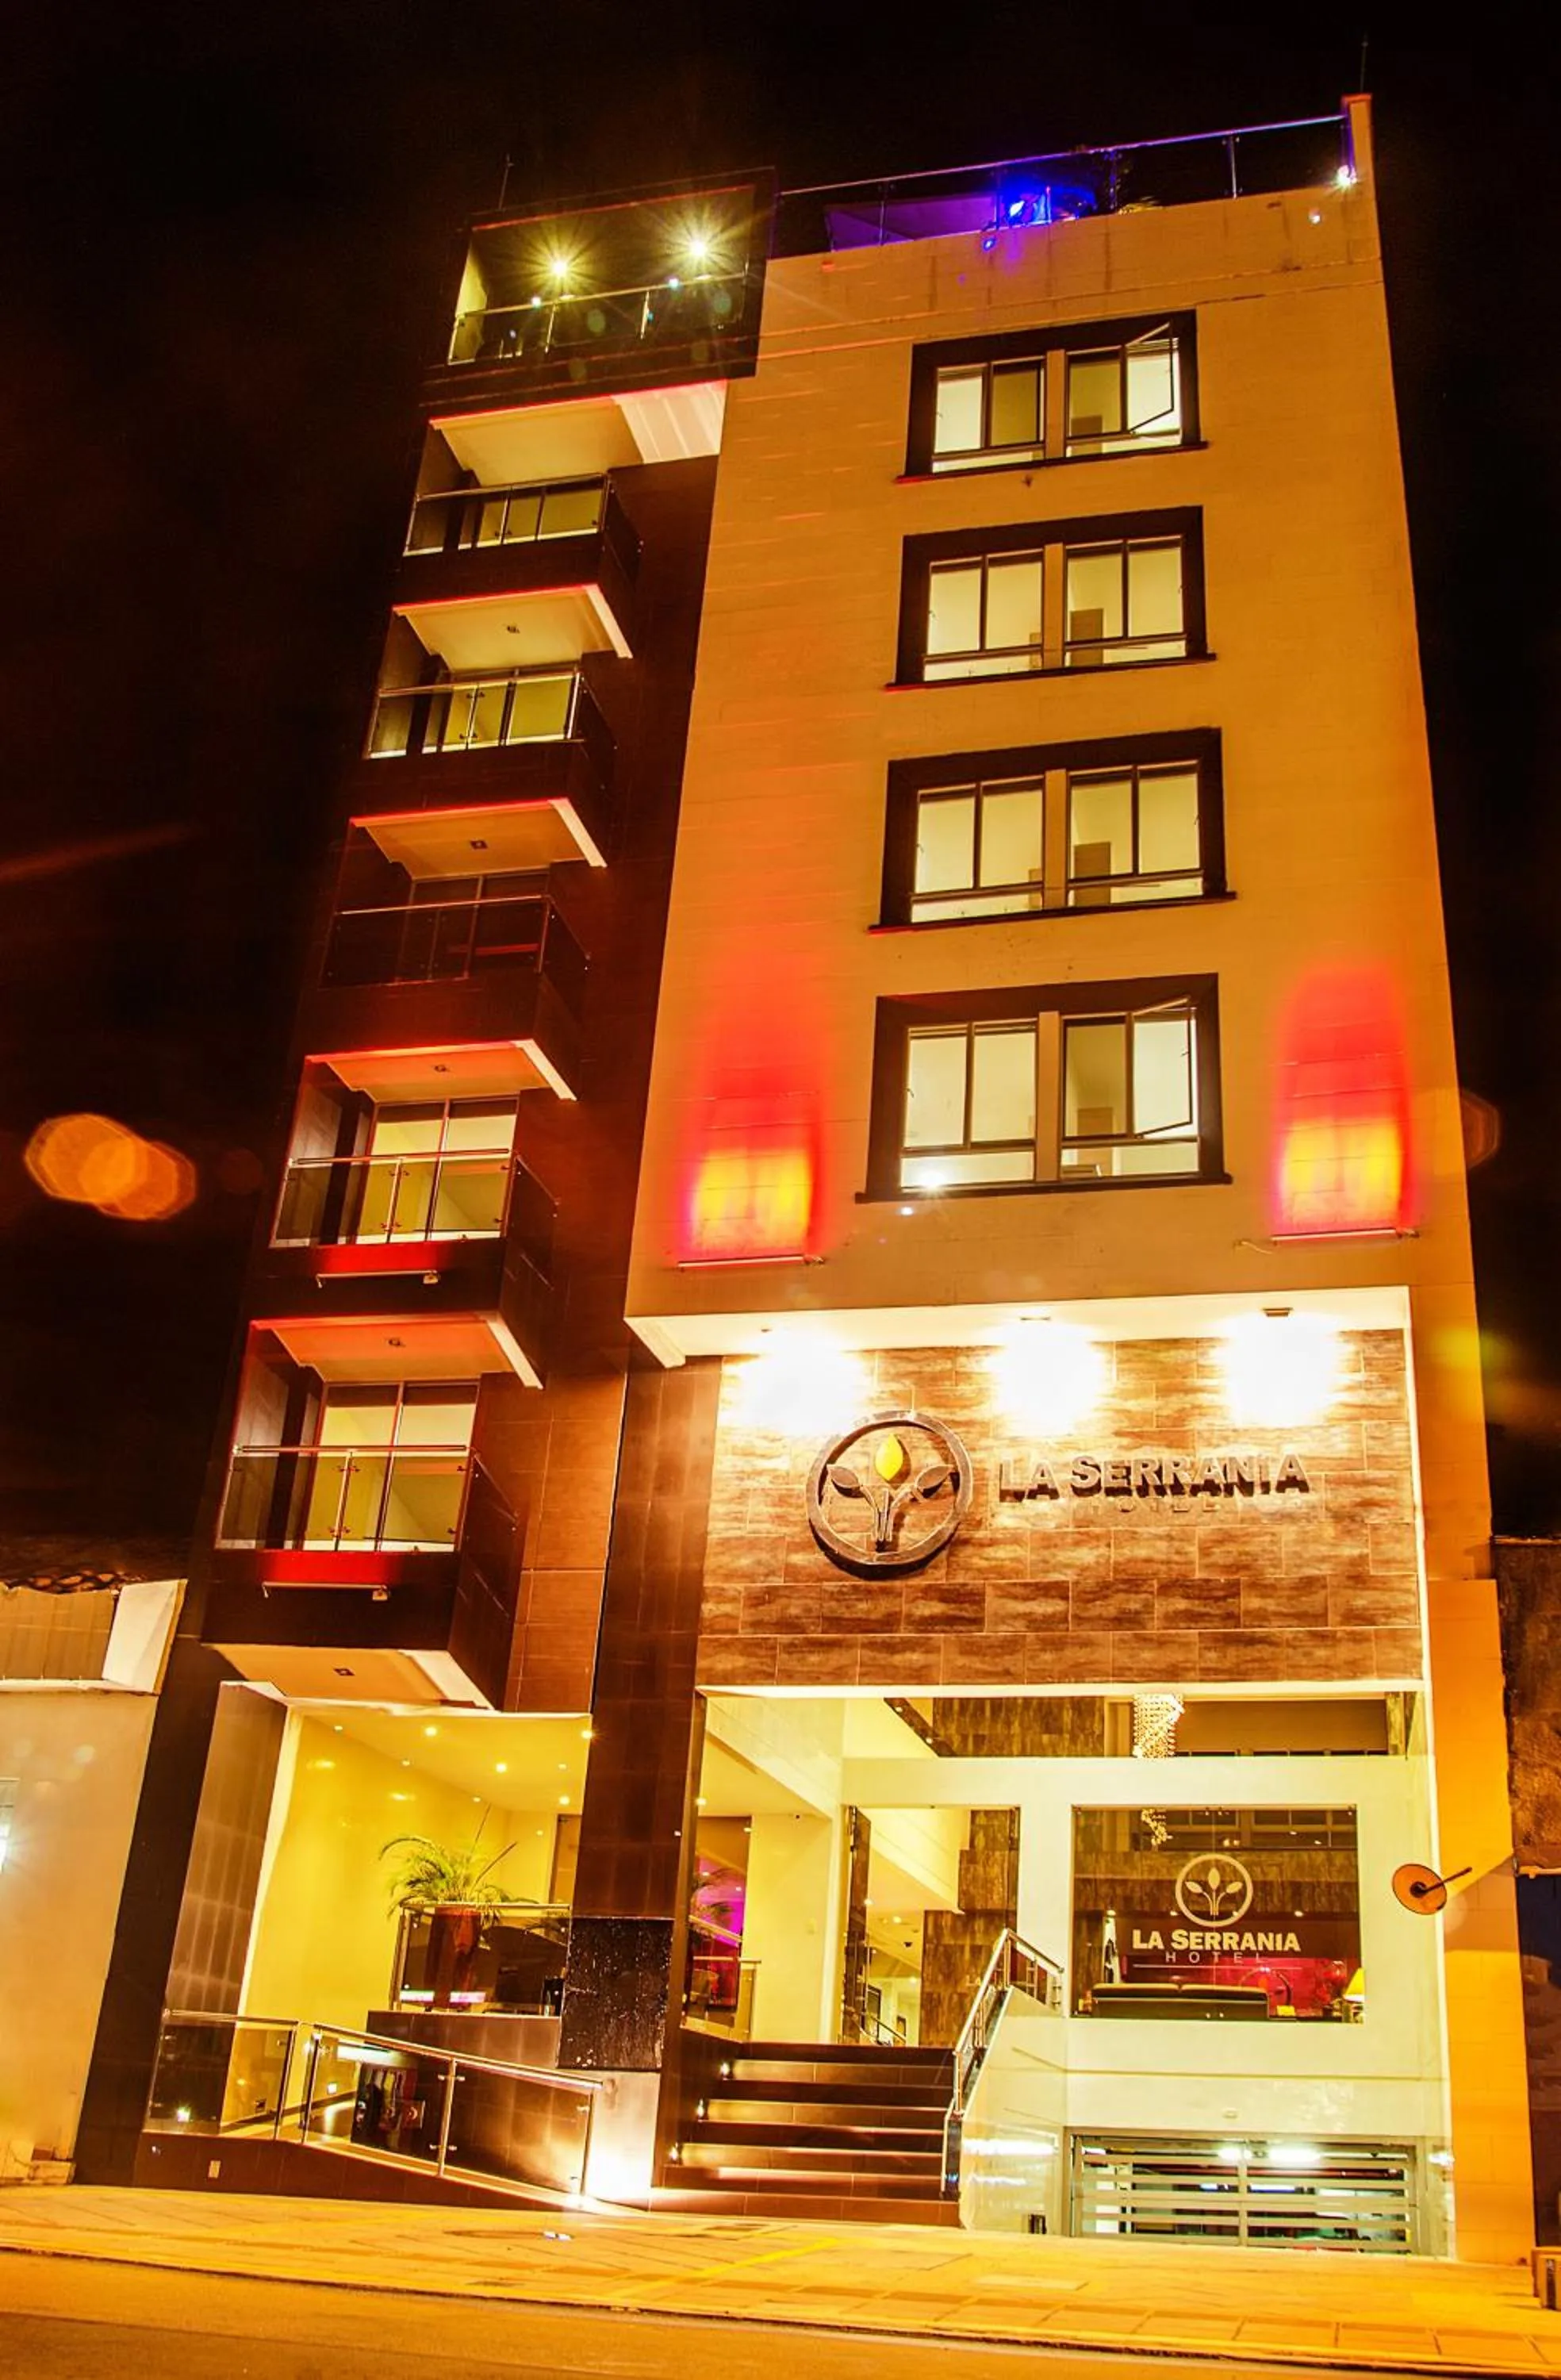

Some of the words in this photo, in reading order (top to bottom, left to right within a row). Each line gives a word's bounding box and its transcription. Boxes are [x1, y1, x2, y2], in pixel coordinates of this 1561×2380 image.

[999, 1457, 1060, 1503] LA
[1070, 1453, 1310, 1499] SERRANIA
[1132, 1929, 1164, 1950] LA
[1171, 1929, 1302, 1952] SERRANIA
[1164, 1952, 1267, 1964] HOTEL
